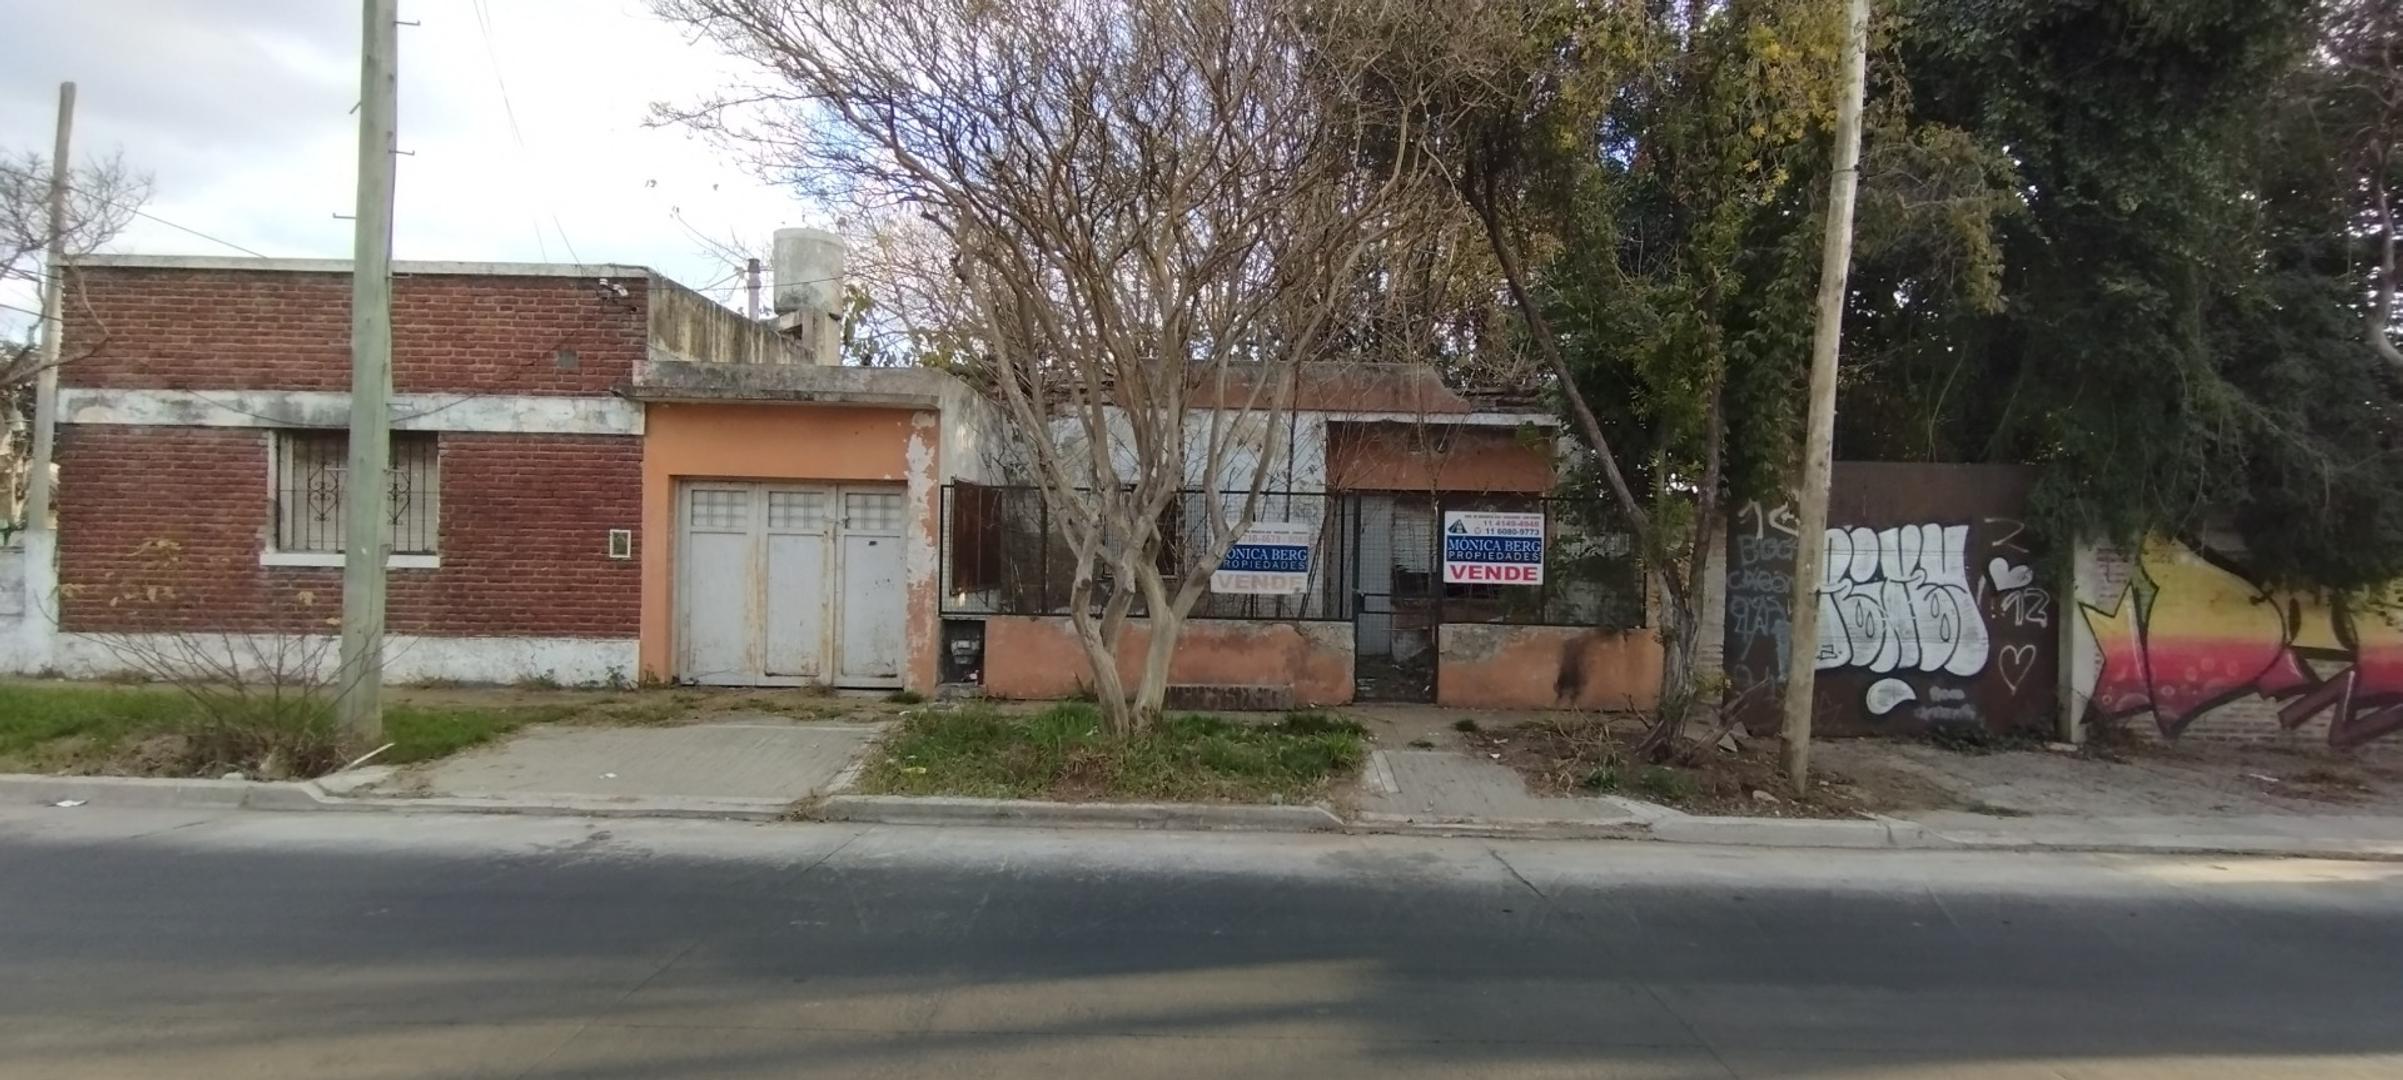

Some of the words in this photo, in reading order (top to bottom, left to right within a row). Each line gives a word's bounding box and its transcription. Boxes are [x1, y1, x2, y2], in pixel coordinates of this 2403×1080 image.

[1448, 535, 1501, 551] MÓNICA
[1505, 540, 1541, 552] BERG
[1271, 549, 1307, 561] BERG
[1448, 551, 1540, 561] PROPIEDADES
[1223, 560, 1306, 570] ROPIEDADES
[1450, 564, 1538, 580] VENDE
